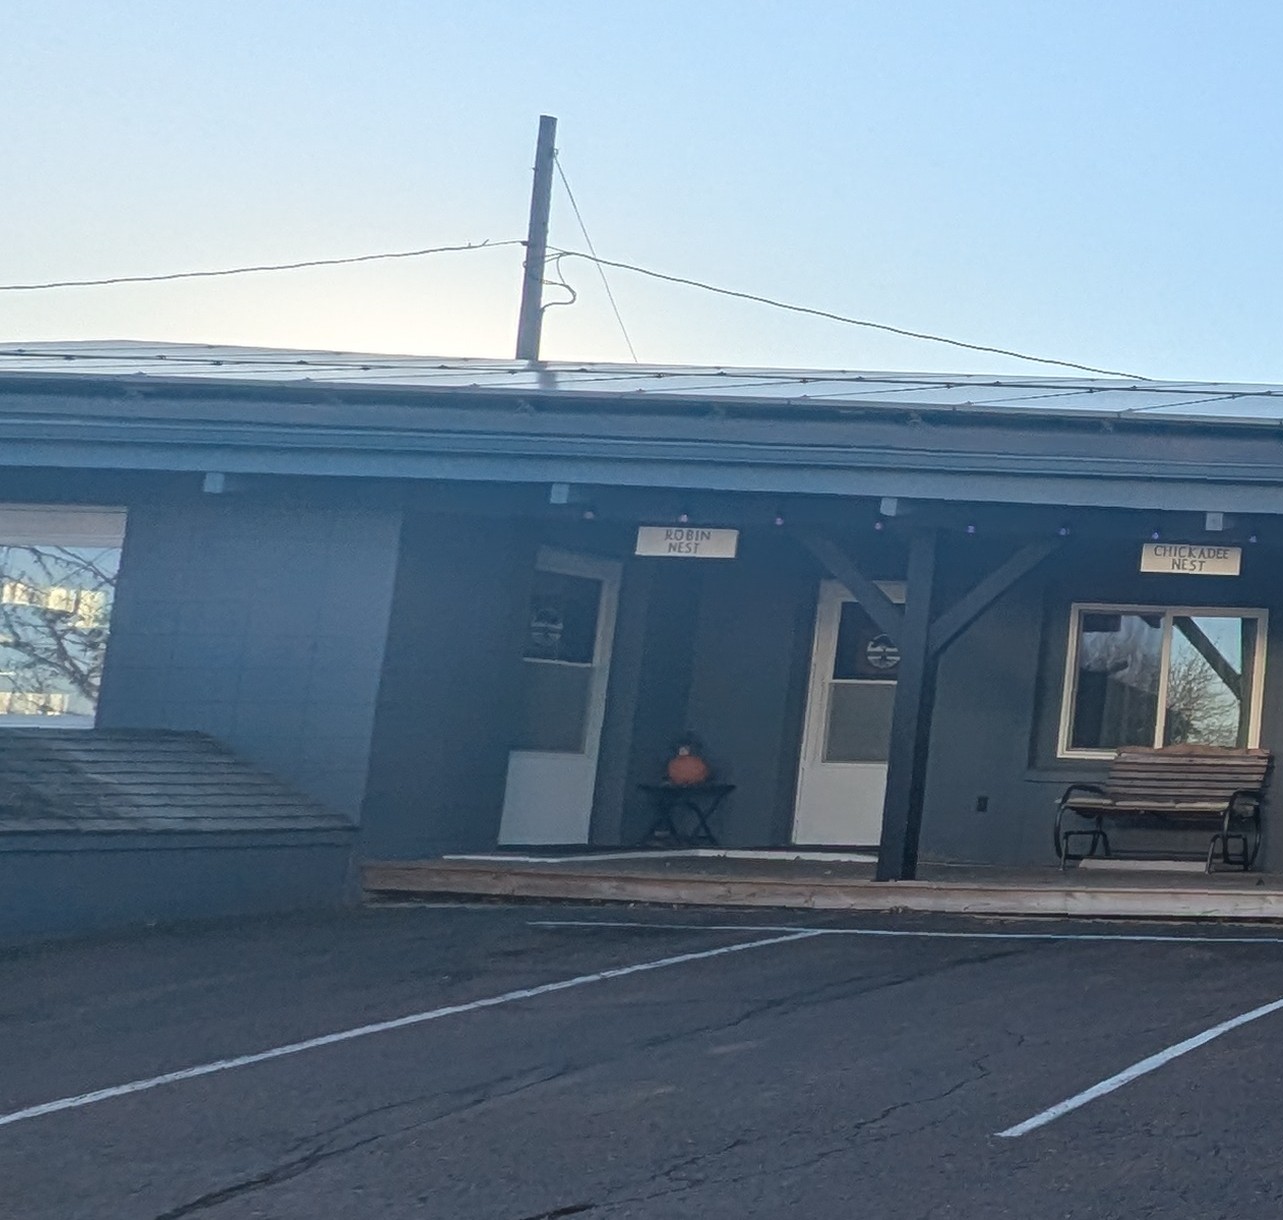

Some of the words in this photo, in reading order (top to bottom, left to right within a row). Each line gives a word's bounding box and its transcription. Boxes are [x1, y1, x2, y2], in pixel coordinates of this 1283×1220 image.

[664, 529, 711, 541] ROBIN
[668, 542, 701, 554] NEST
[1154, 545, 1231, 559] CHICKADEE
[1171, 558, 1206, 571] NEST
